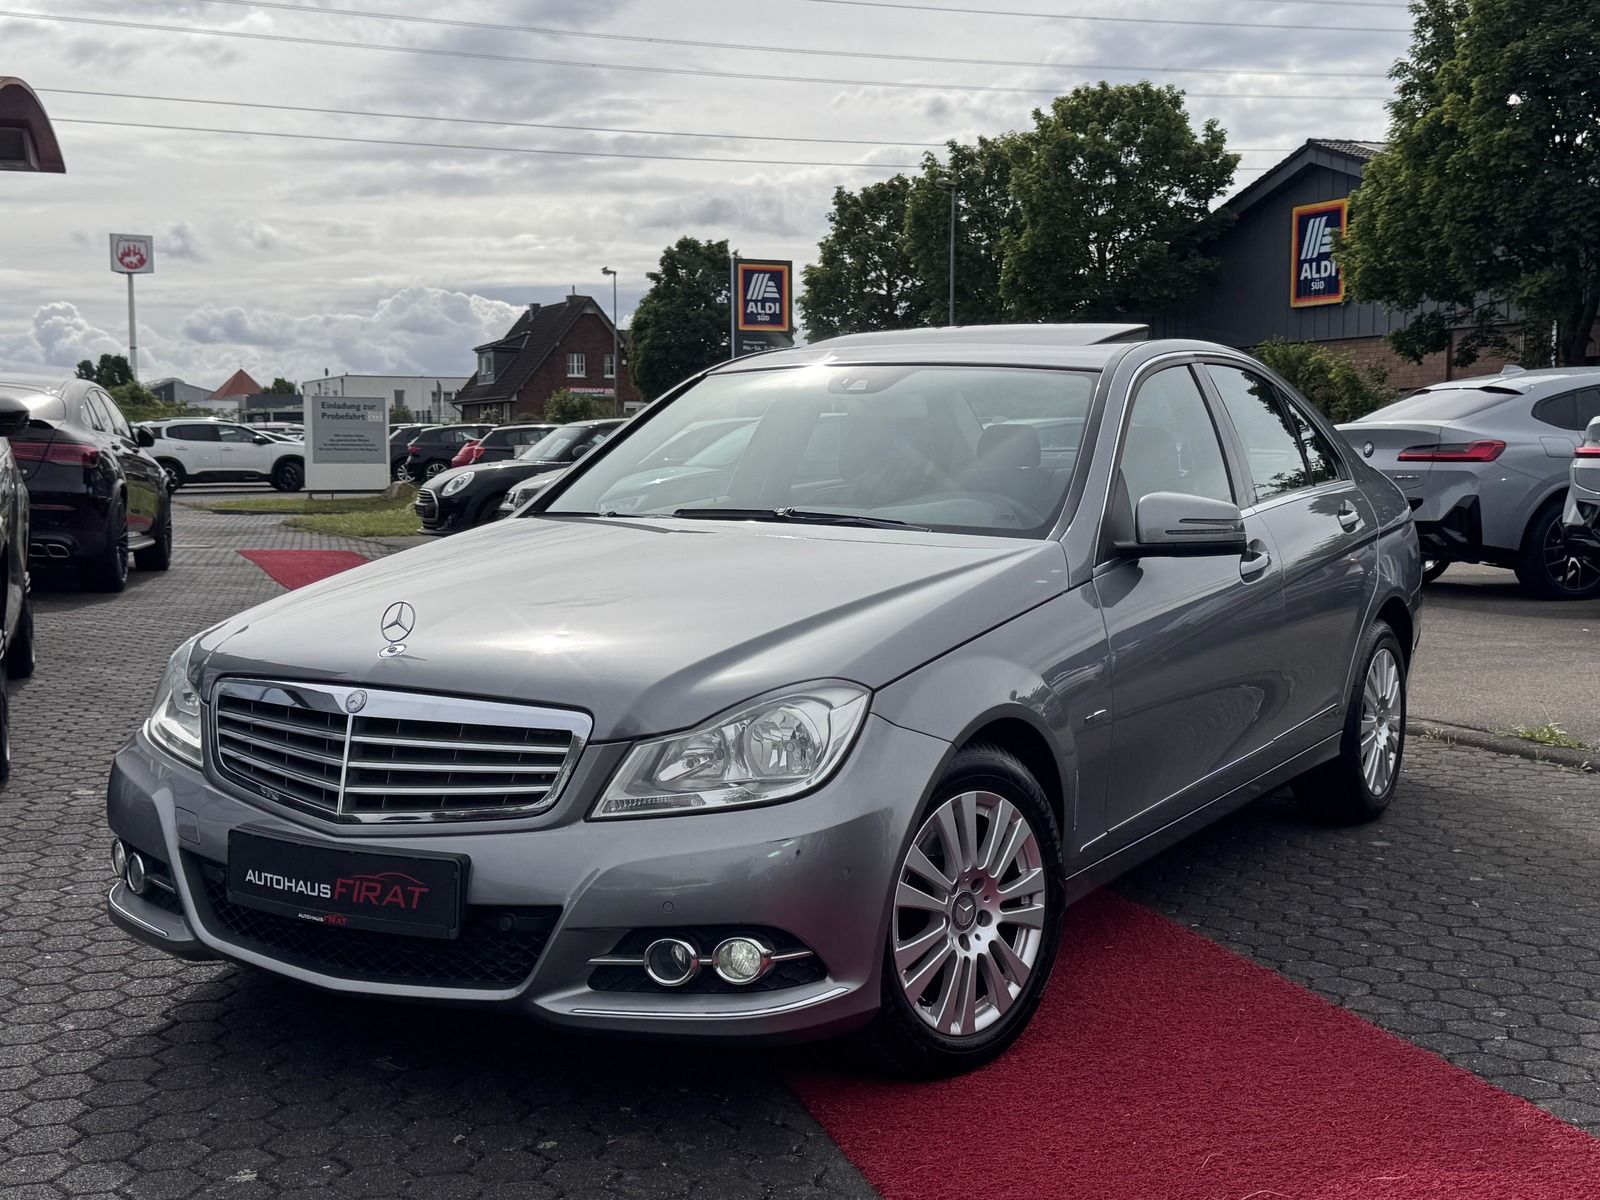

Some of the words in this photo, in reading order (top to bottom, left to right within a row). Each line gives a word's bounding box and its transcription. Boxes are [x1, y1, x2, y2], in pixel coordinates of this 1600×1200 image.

[1300, 260, 1336, 280] ALDI
[1311, 279, 1325, 290] SÜD
[746, 301, 780, 314] ALDI
[321, 401, 361, 411] Einladung
[321, 412, 365, 420] Probefahrt
[245, 869, 331, 899] AUTOHAUS
[334, 878, 430, 909] FIRAT
[298, 913, 324, 922] AUTOHAUS
[324, 914, 348, 926] FIRAT
